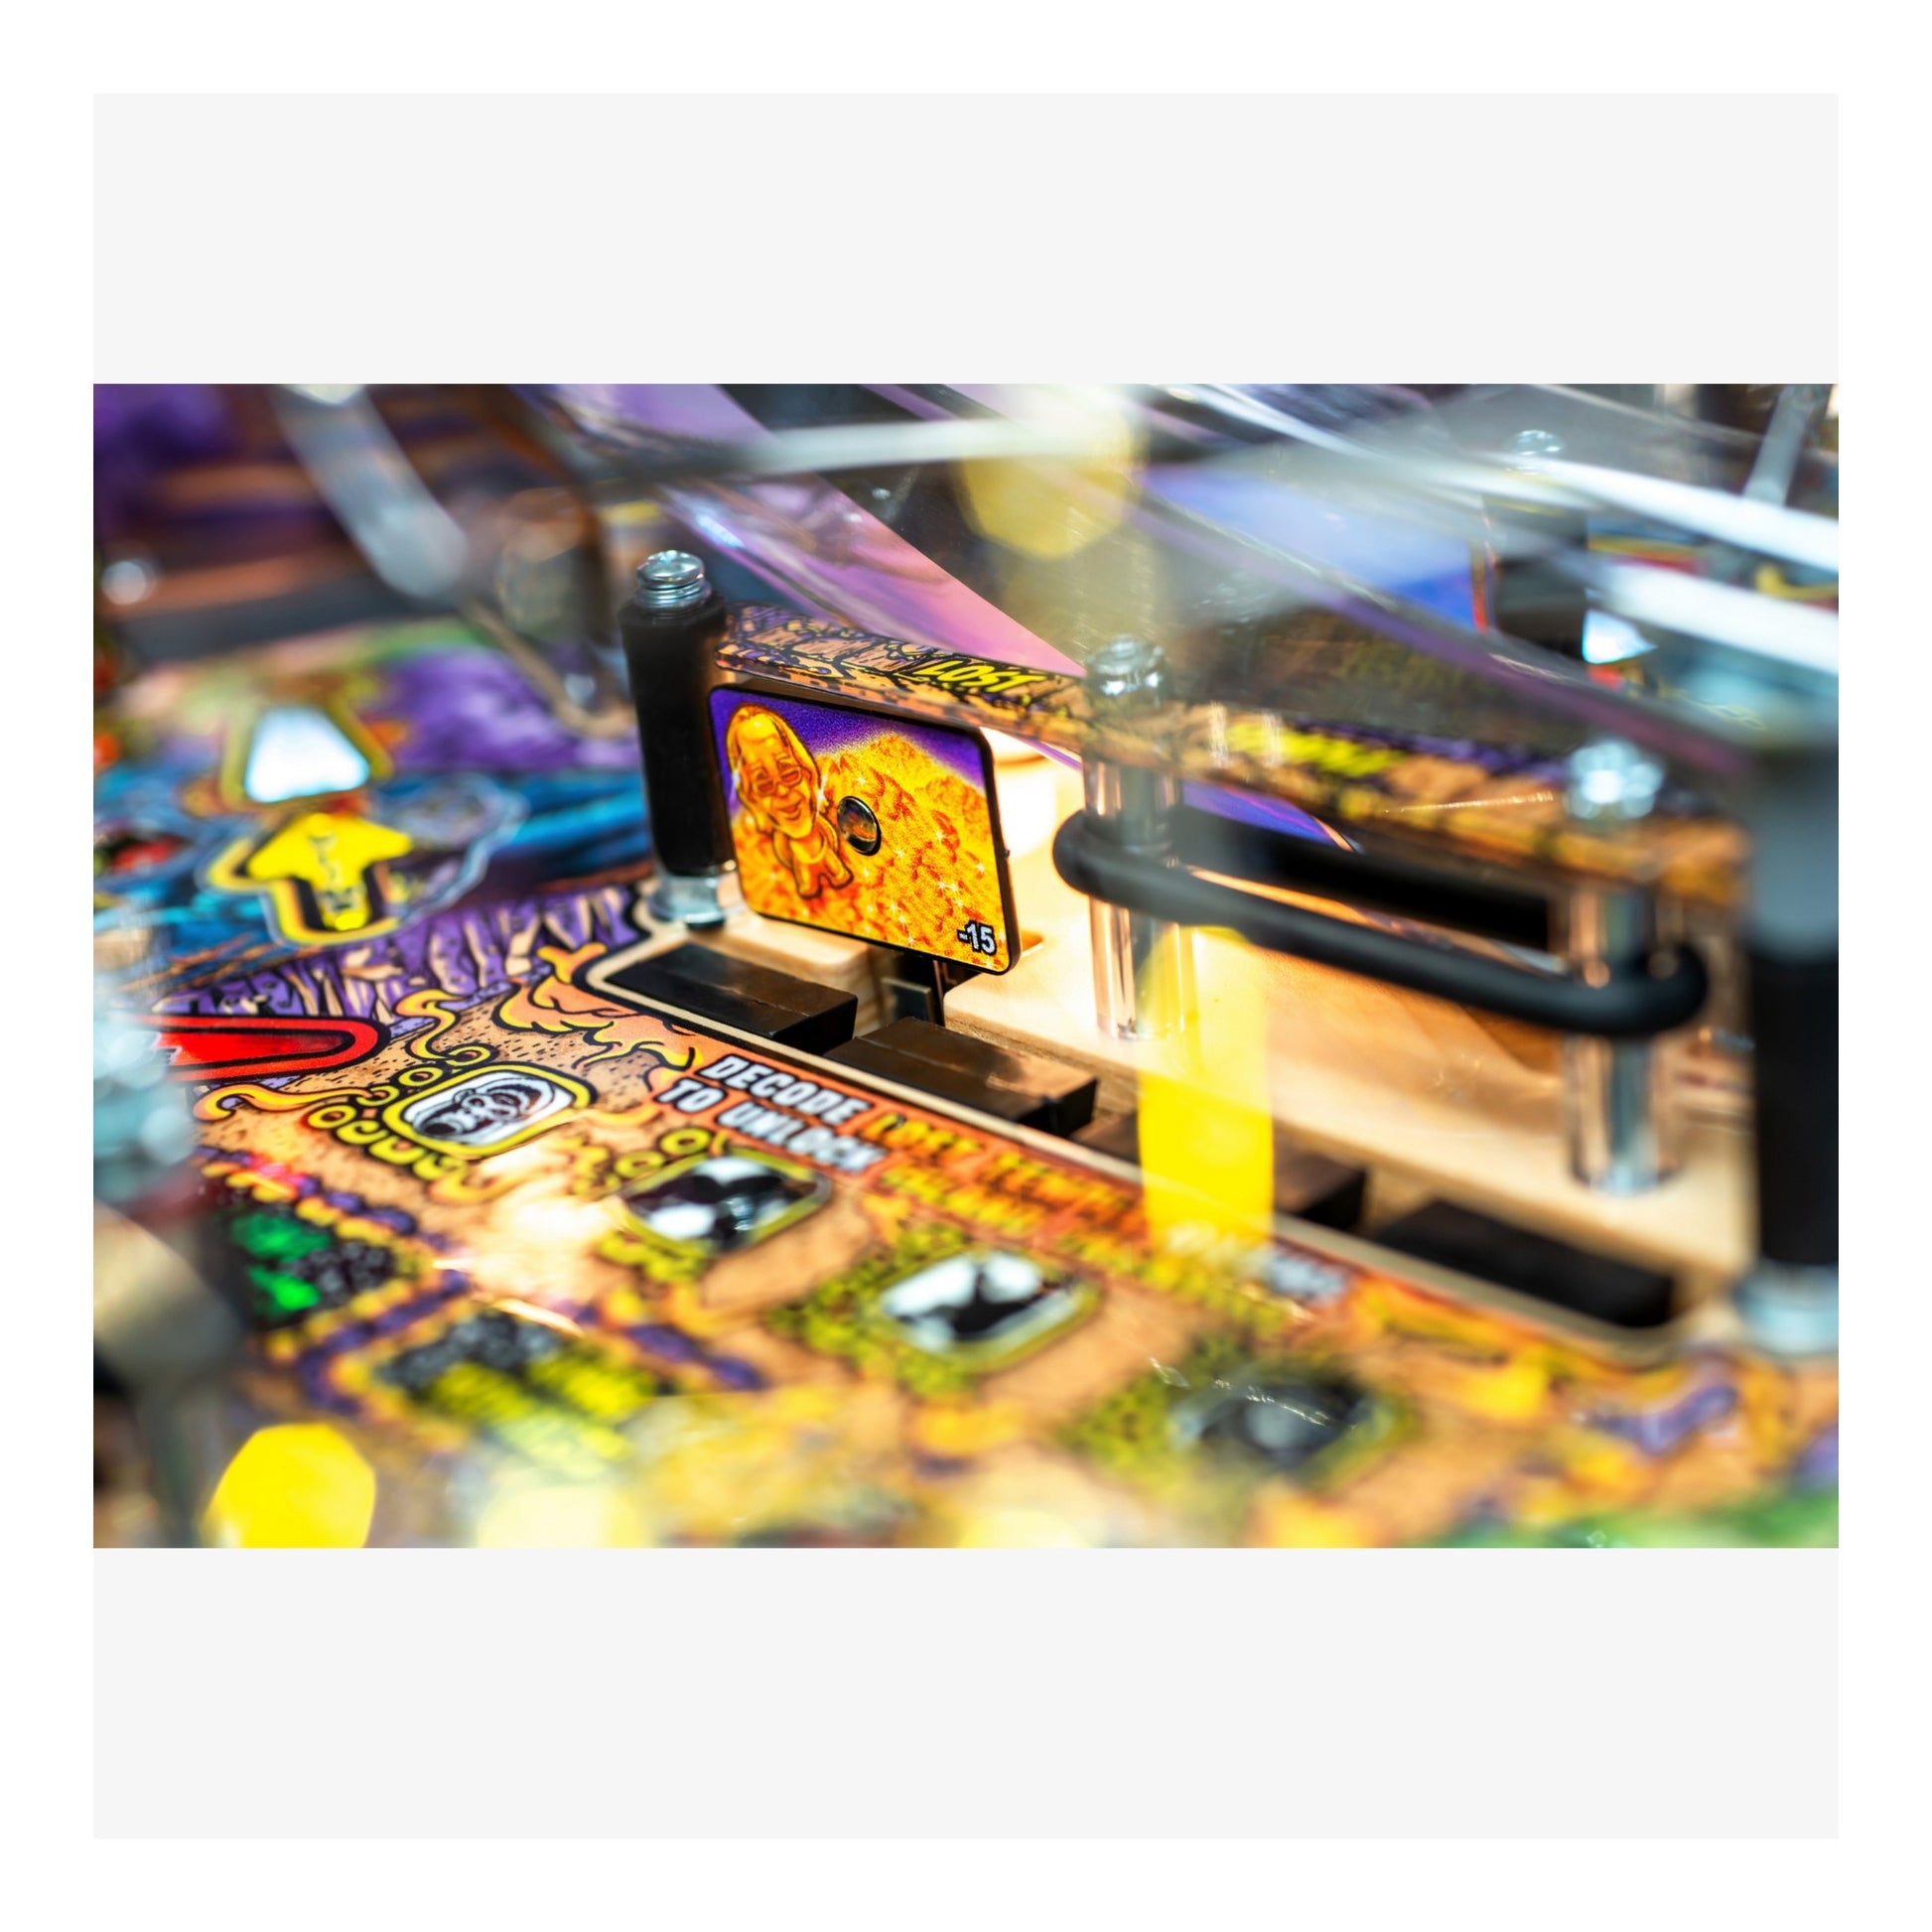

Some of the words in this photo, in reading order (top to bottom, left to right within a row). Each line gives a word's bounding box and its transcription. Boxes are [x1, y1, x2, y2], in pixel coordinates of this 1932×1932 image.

[912, 660, 1047, 693] LOST
[957, 921, 997, 955] -15
[697, 1054, 874, 1126] DECODE
[654, 1078, 726, 1113] TO
[717, 1100, 889, 1173] UNLOCK
